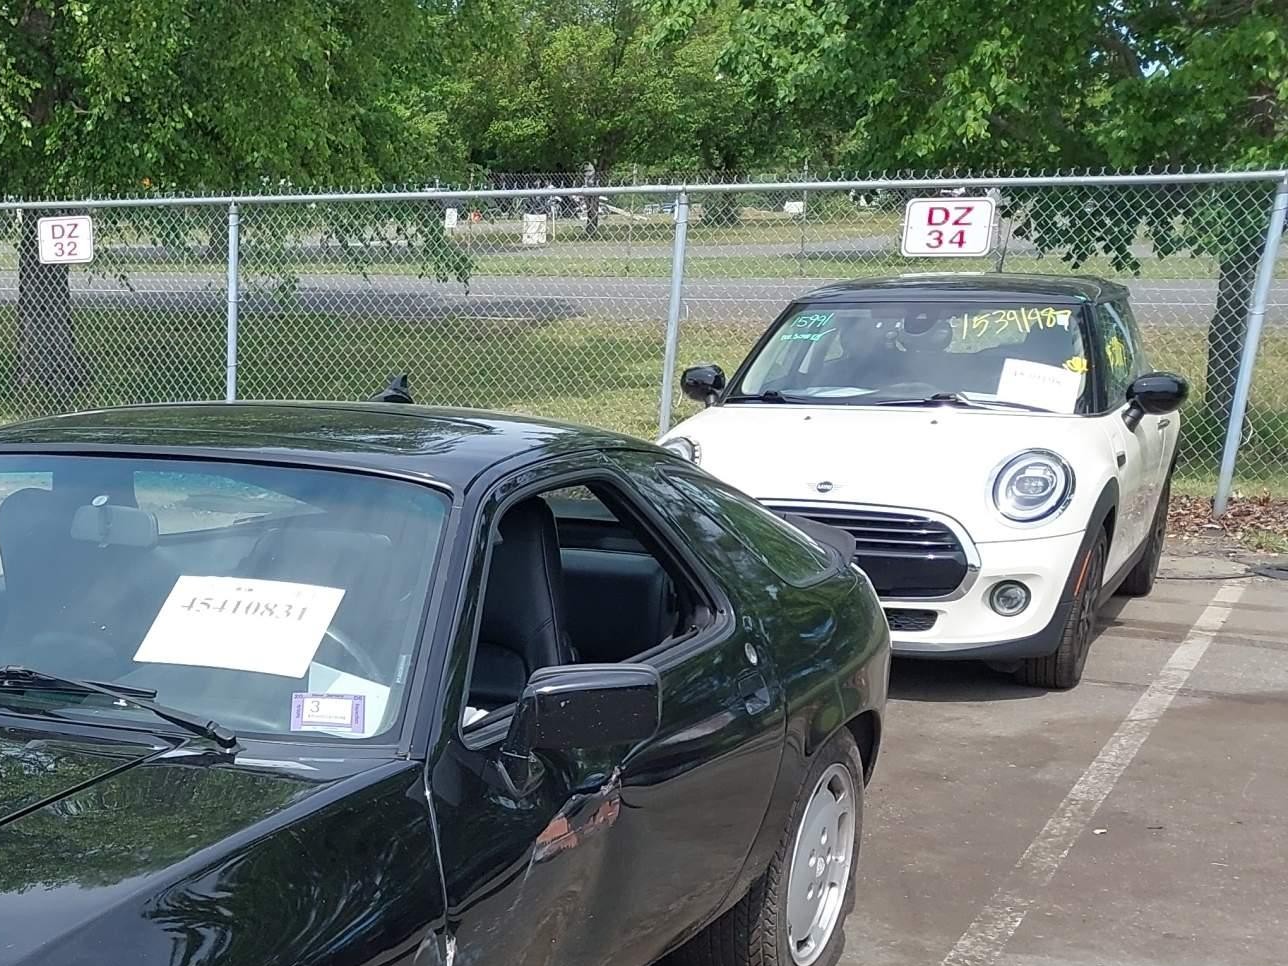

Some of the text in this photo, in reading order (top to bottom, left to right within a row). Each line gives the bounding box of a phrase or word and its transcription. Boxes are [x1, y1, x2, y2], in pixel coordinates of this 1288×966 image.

[926, 206, 975, 226] DZ
[51, 223, 80, 240] DZ
[925, 229, 967, 249] 34
[54, 241, 78, 257] 32
[181, 597, 308, 622] 45410831
